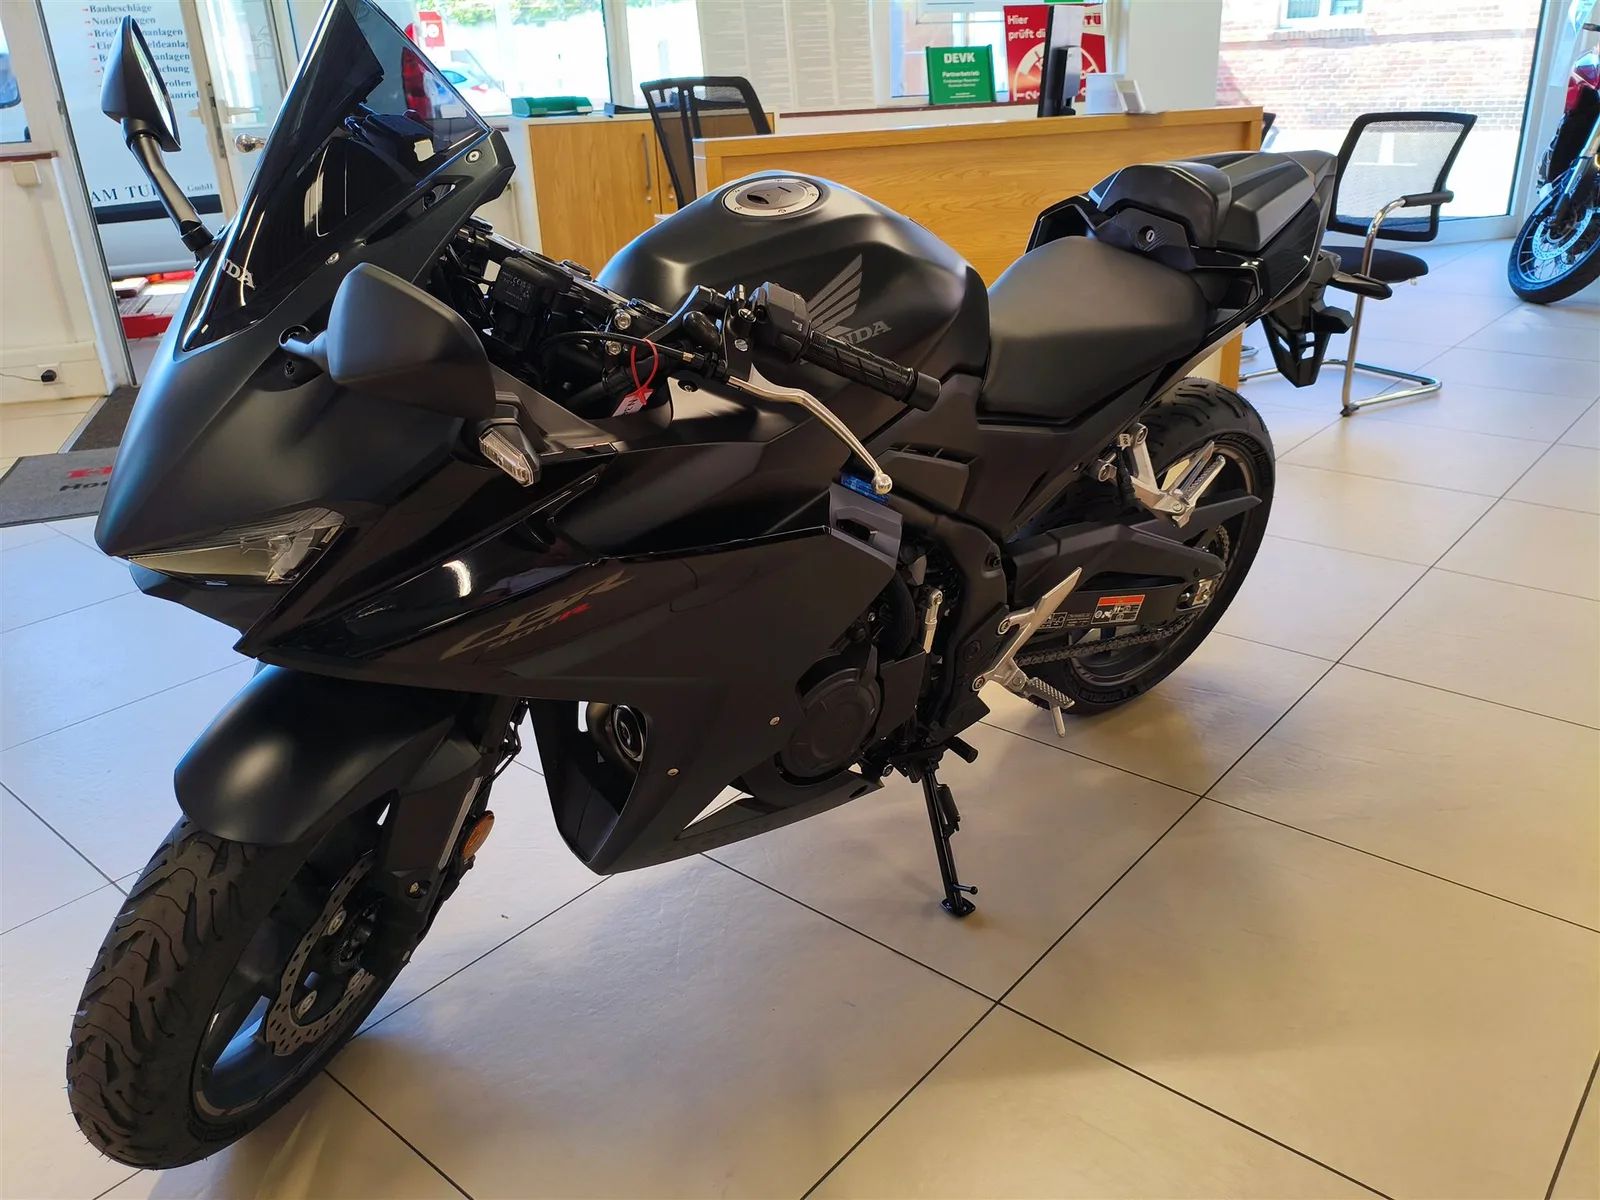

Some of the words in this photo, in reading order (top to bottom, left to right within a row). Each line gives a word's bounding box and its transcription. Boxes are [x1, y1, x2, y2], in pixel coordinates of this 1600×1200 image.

[90, 4, 152, 13] Baubeschläge
[1007, 15, 1029, 25] Hier
[1084, 13, 1101, 25] TÜ
[1008, 28, 1034, 41] prüft
[1035, 29, 1046, 38] di
[943, 52, 975, 64] DEVK
[187, 183, 213, 192] GmbH
